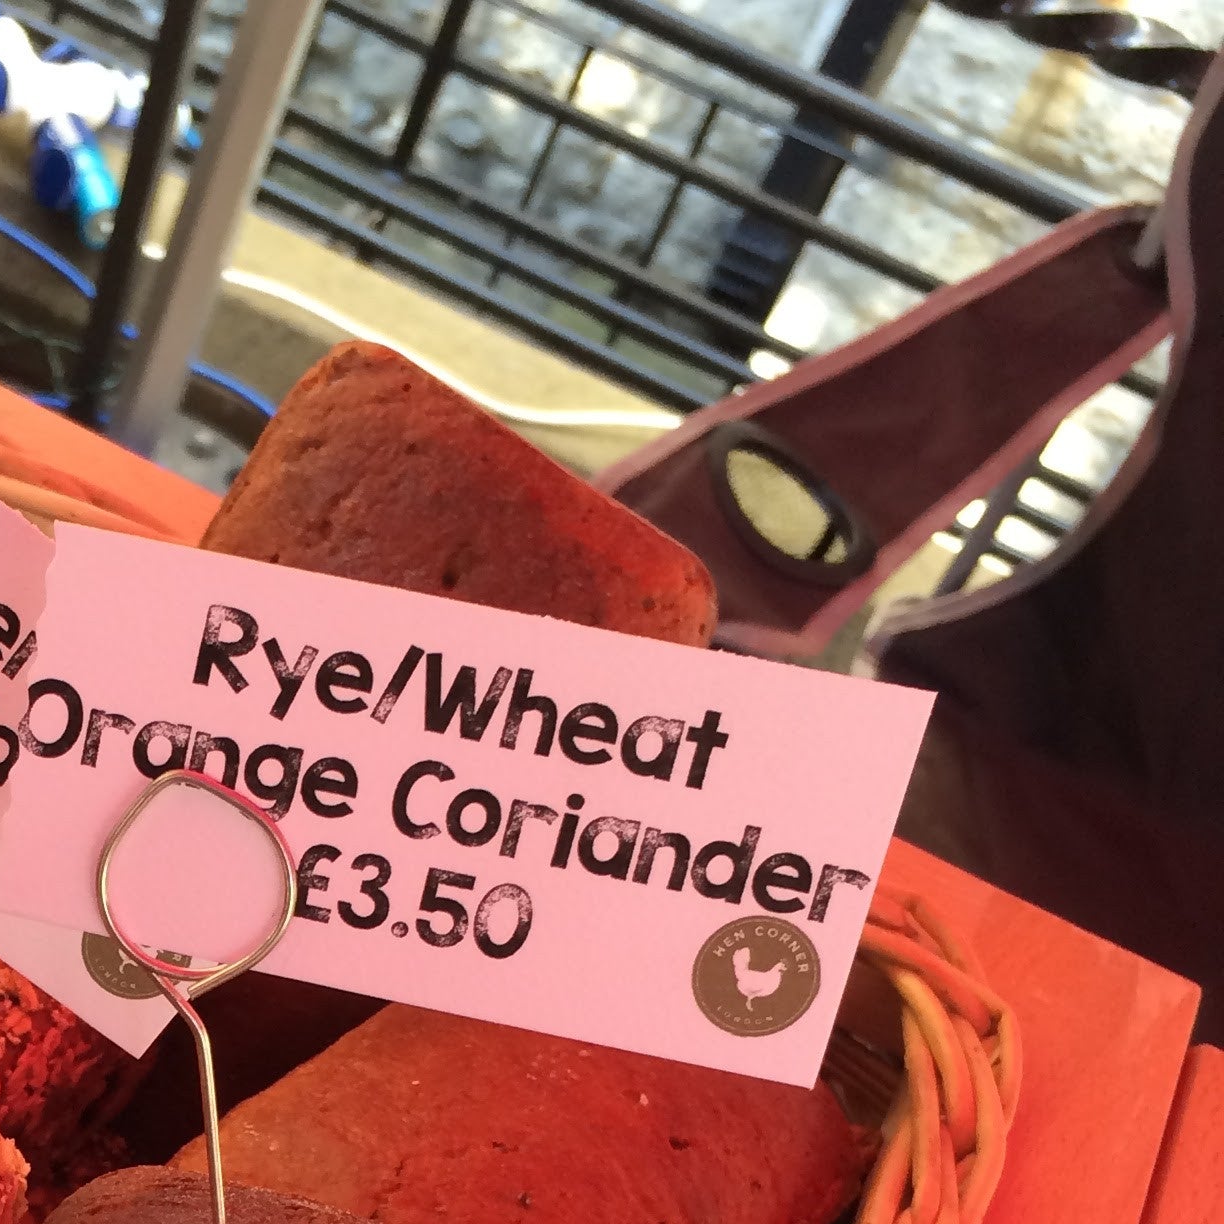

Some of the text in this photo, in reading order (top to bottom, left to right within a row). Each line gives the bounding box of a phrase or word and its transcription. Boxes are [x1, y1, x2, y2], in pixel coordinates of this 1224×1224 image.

[192, 604, 729, 791] Rye/Wheat
[18, 678, 872, 923] Orange Coriander
[293, 843, 533, 961] £3.50
[712, 925, 810, 973] HEN CORNER
